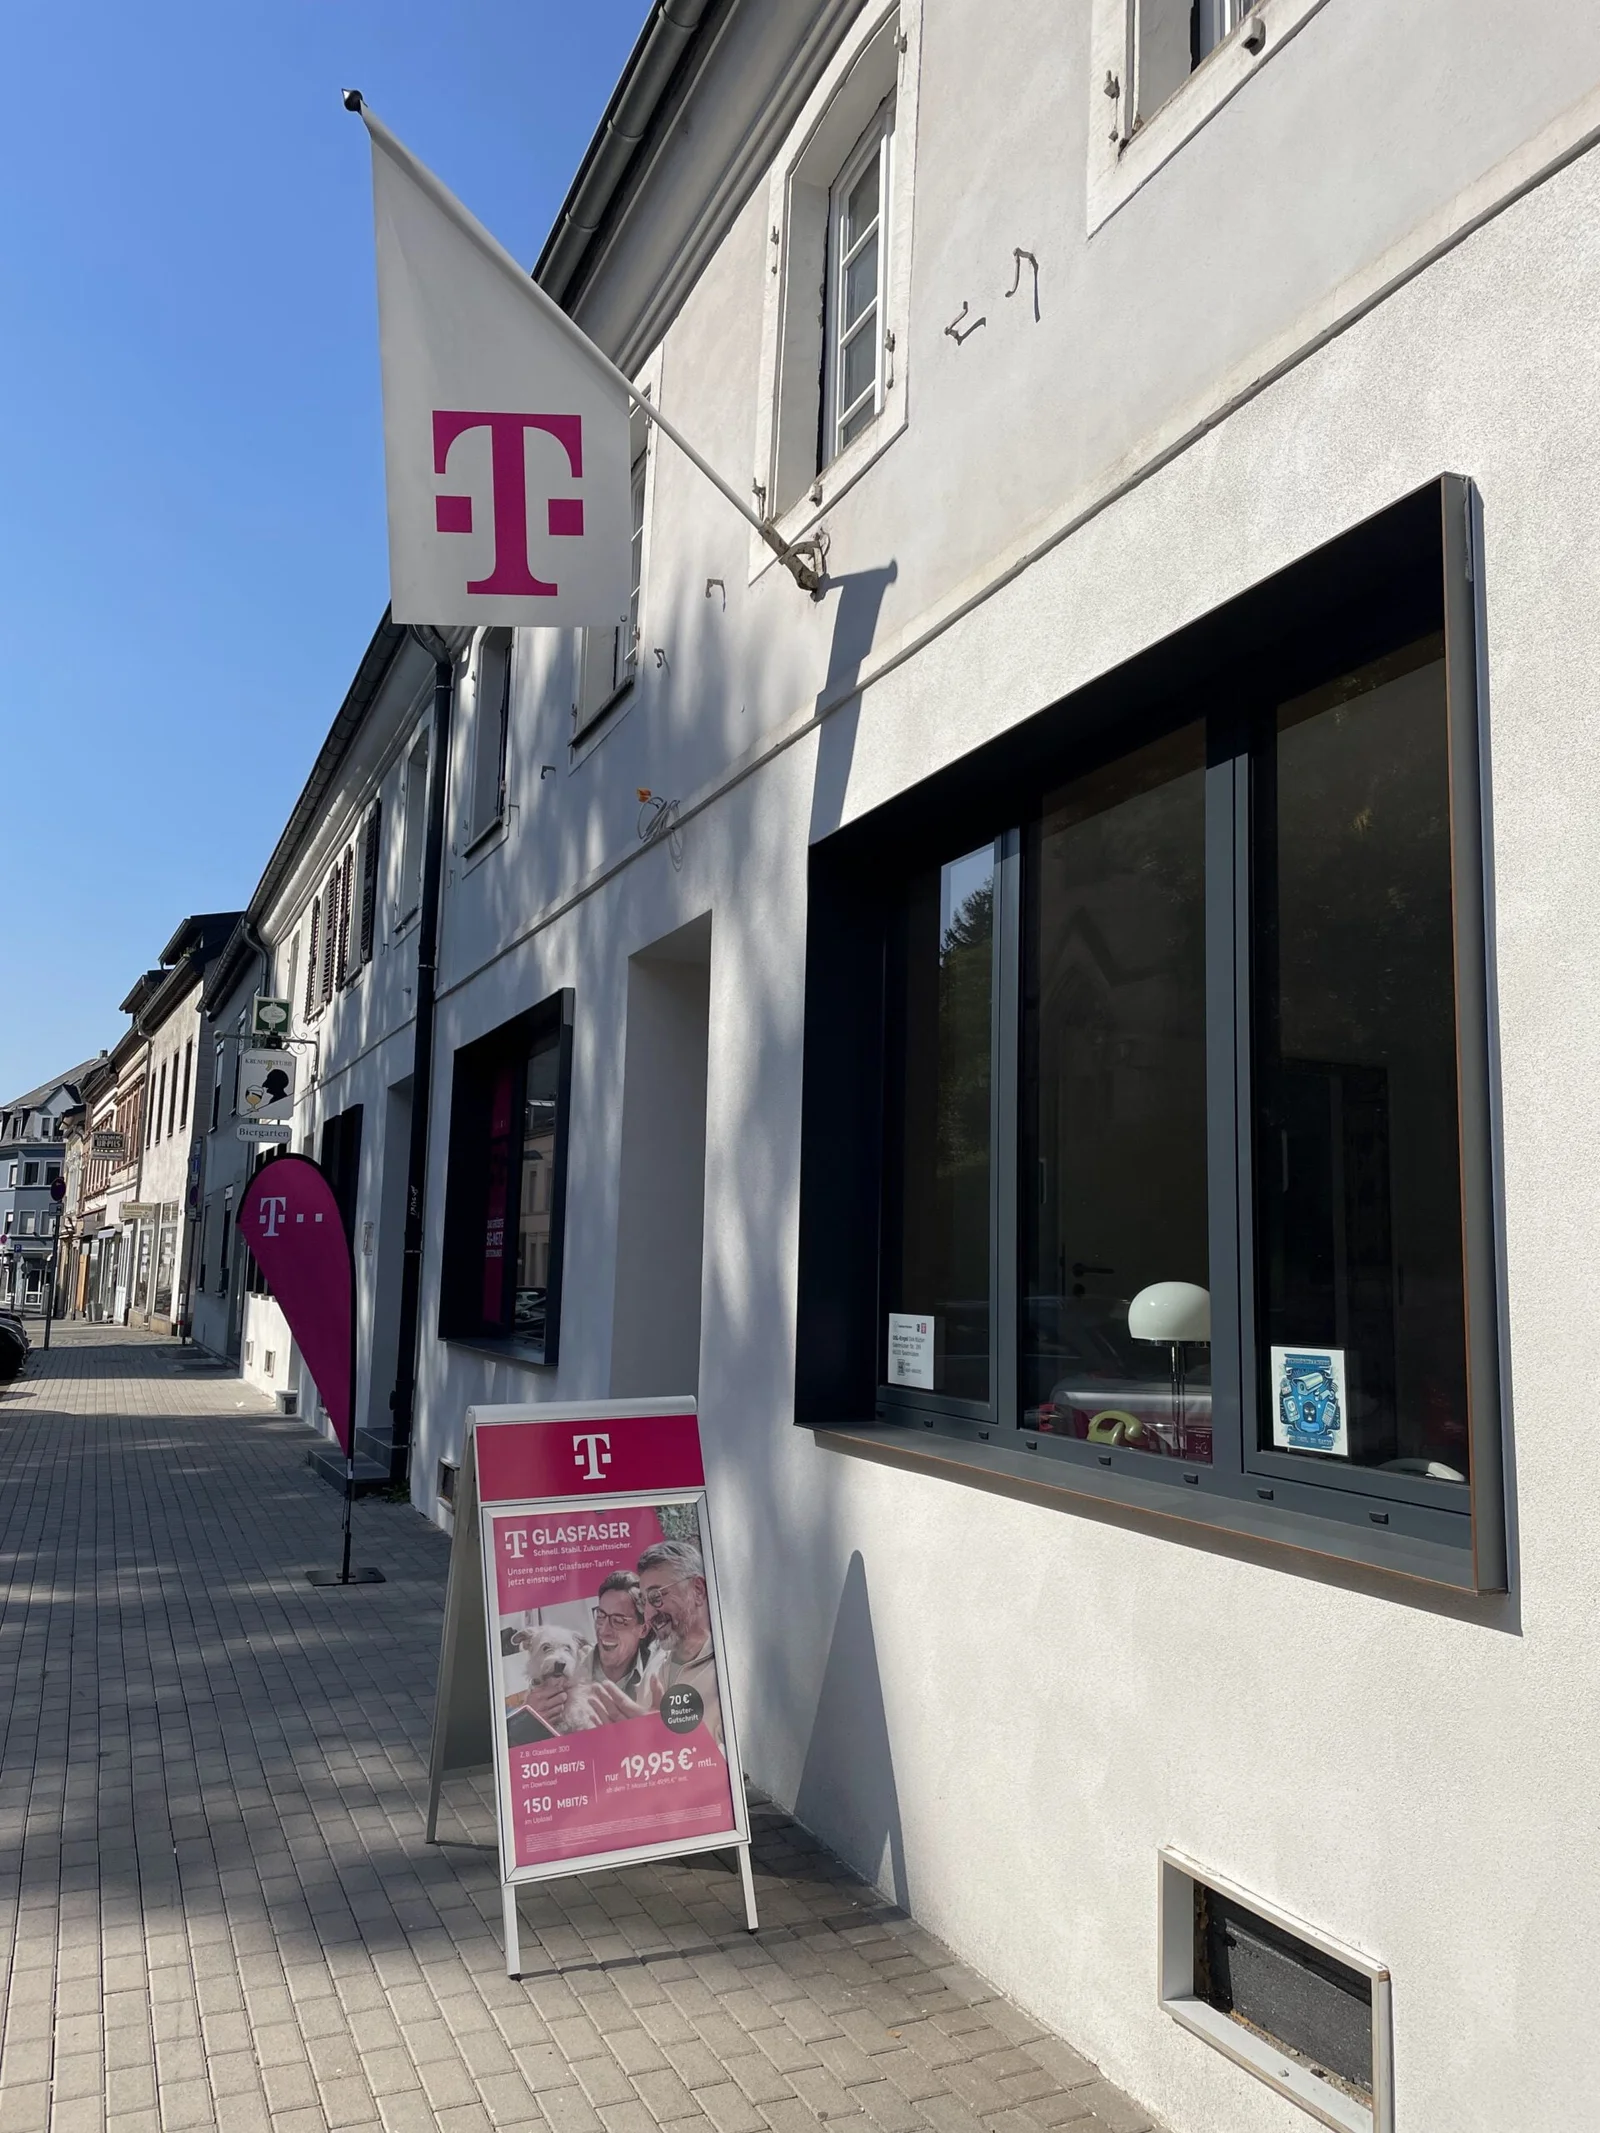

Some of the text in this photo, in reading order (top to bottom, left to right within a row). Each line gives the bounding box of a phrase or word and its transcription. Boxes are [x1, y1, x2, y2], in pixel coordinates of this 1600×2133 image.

[432, 410, 584, 596] T
[239, 1128, 290, 1138] Biergarten
[573, 1433, 612, 1480] T
[532, 1522, 630, 1545] GLASFASER
[504, 1530, 528, 1559] T
[533, 1542, 633, 1557] Schnell. Stabil. Zukunftssicher.
[507, 1566, 534, 1576] Unsere
[534, 1564, 558, 1574] neuen
[558, 1558, 614, 1571] Glasfaser-Tarife
[507, 1573, 567, 1588] jetzt einsteigen!
[669, 1695, 682, 1706] 70
[667, 1714, 699, 1725] Gutschrift
[670, 1707, 694, 1716] Router-
[521, 1760, 586, 1779] 300 MBIT/S
[604, 1773, 619, 1782] nur
[620, 1750, 675, 1781] 19,95
[523, 1795, 589, 1814] 150 MBIT/S
